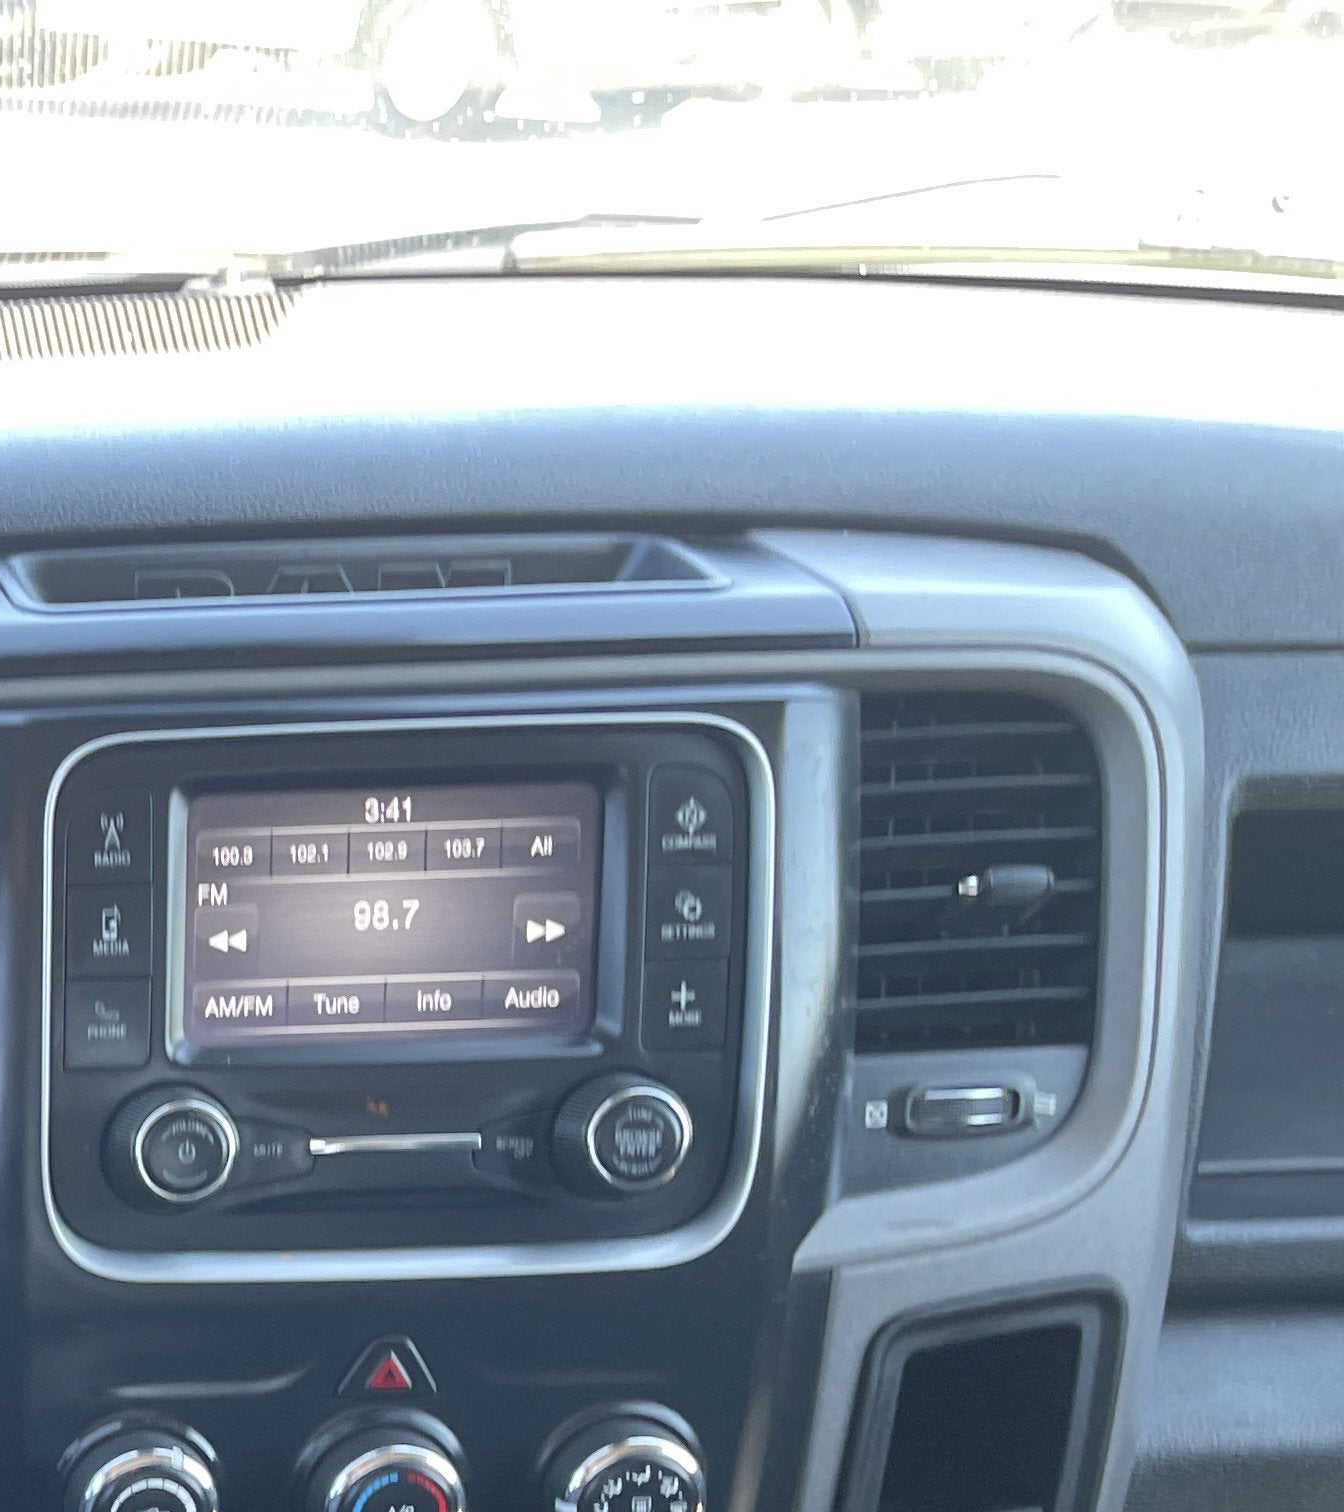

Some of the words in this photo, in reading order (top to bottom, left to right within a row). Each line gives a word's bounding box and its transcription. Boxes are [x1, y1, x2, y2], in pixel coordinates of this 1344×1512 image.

[530, 834, 554, 858] All
[197, 882, 229, 907] FM
[353, 898, 421, 932] 98.7
[204, 993, 274, 1019] AM/FM
[313, 991, 361, 1016] Tune
[416, 989, 453, 1013] Info
[503, 985, 561, 1011] Audio
